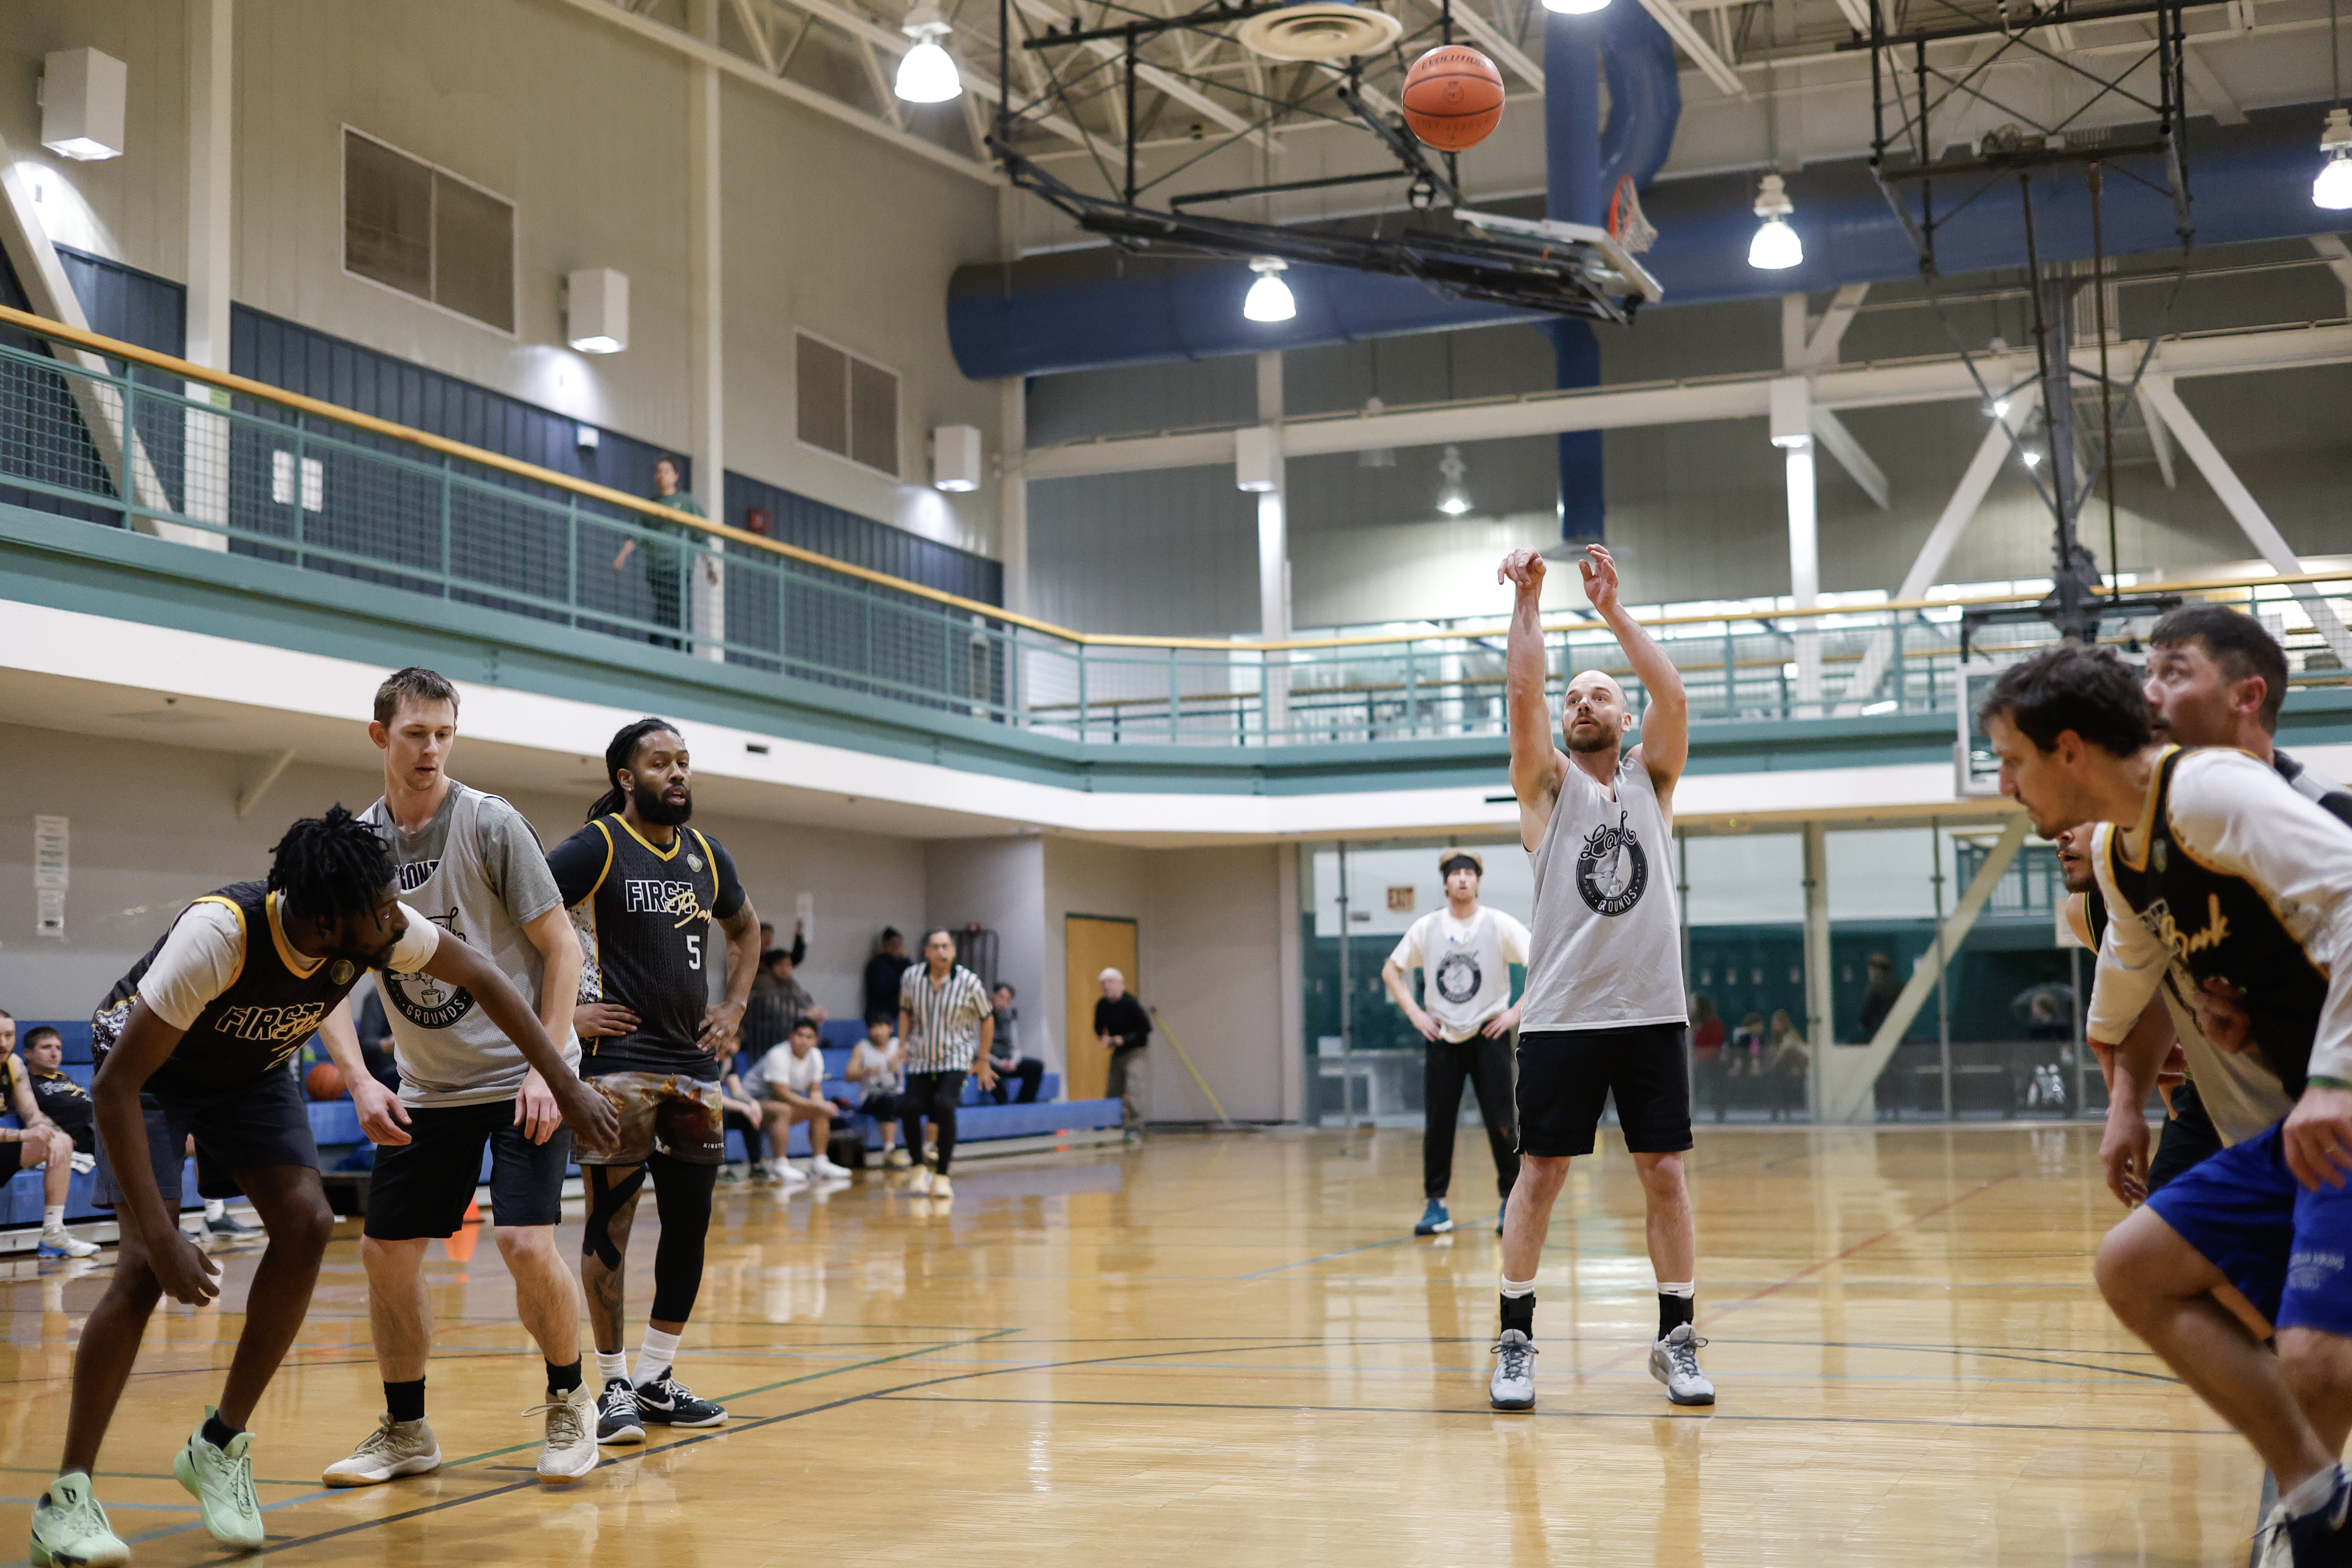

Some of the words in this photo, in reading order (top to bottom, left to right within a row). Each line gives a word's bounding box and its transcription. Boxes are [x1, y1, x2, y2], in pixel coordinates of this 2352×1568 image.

[625, 879, 693, 914] FIRST
[686, 935, 701, 970] 5
[214, 1002, 325, 1040] FIRST
[406, 998, 465, 1025] GROUNDS
